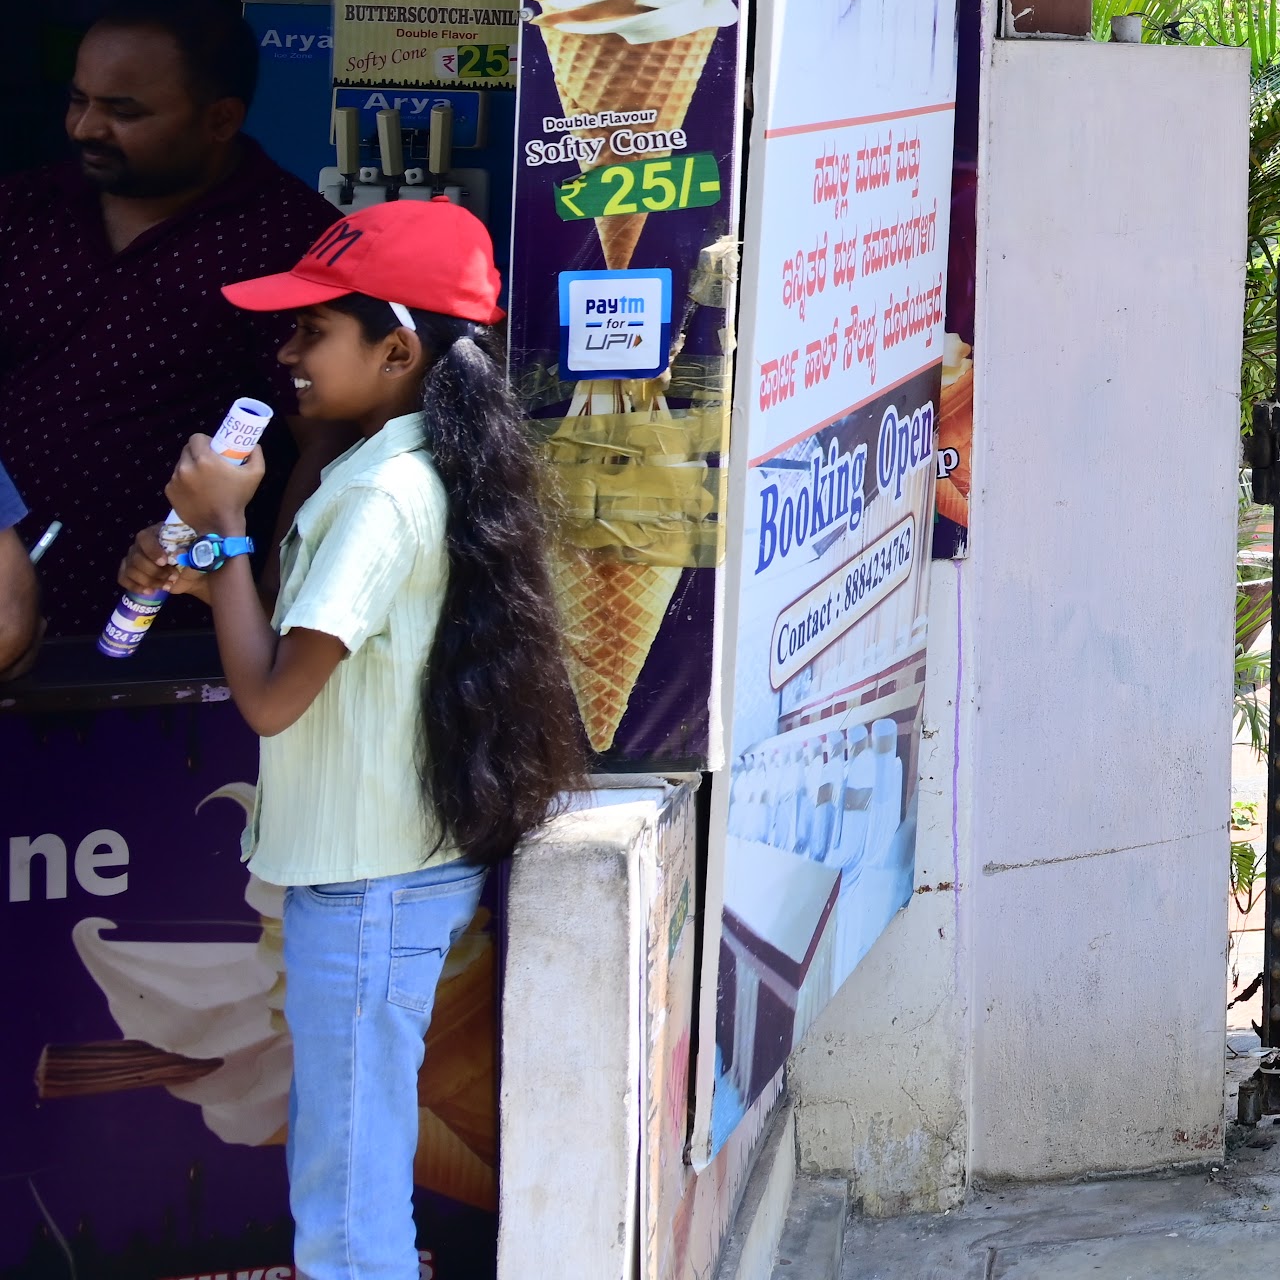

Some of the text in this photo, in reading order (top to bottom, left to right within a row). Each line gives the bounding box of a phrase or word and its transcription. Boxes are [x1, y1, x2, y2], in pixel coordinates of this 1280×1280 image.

[261, 29, 334, 52] Arya
[396, 28, 478, 40] Double Flavor
[346, 47, 427, 73] Softy Cone
[545, 110, 656, 131] Double Flavour
[525, 129, 686, 166] Softy Cone
[855, 129, 892, 193] ಮದುವೆ
[896, 129, 921, 198] ಮತ್ತು
[833, 225, 858, 291] ಶುಭ
[586, 296, 645, 314] paytm
[606, 318, 626, 330] for
[585, 333, 634, 351] UPI
[804, 317, 839, 389] ಹಾಲ್
[224, 416, 264, 436] ESIDE
[755, 407, 933, 576] Booking Open
[777, 526, 911, 665] Contact 8884234762
